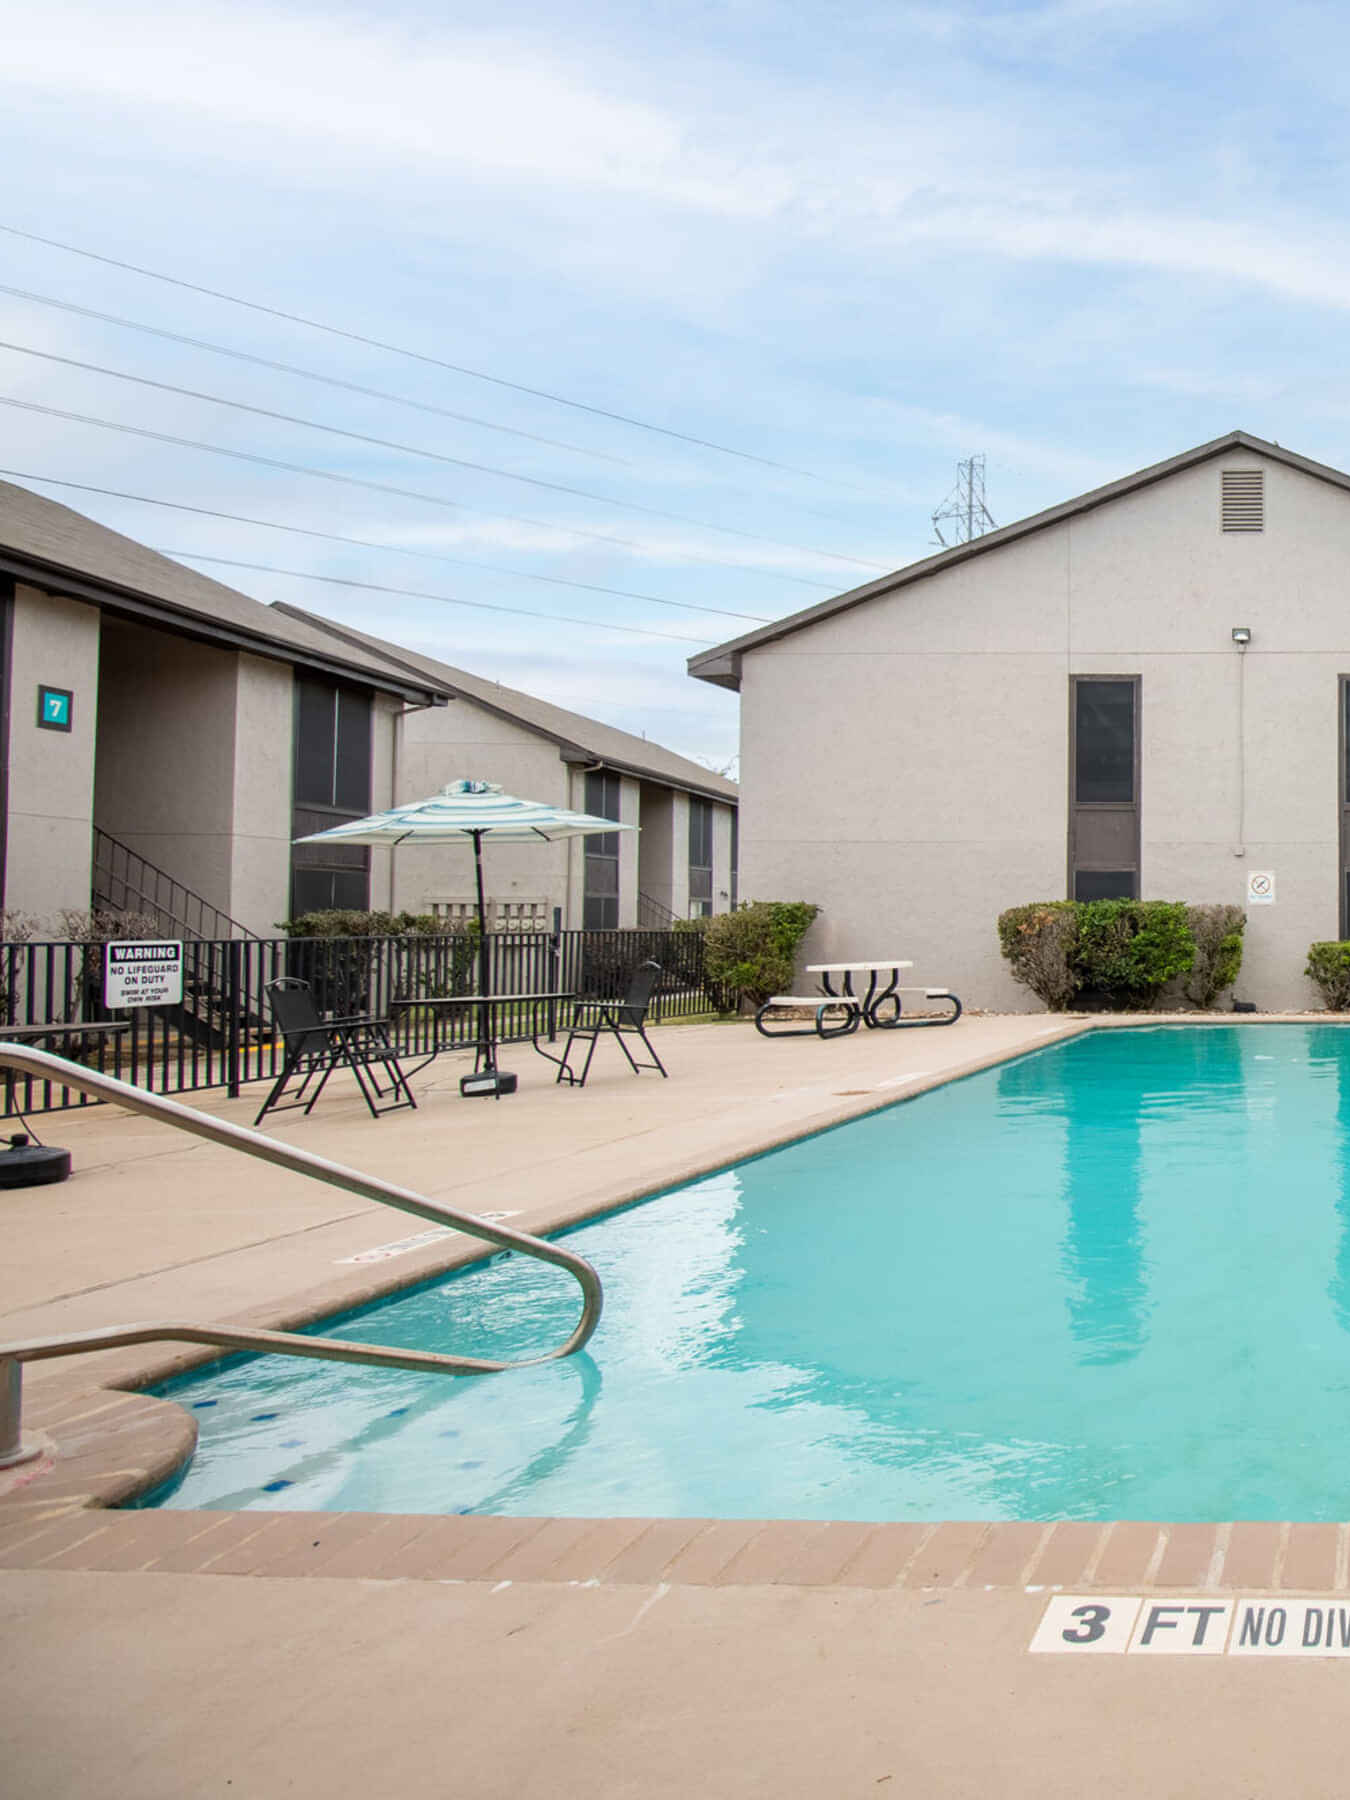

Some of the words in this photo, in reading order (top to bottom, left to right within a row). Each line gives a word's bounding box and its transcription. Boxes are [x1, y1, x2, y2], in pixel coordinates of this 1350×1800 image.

[49, 699, 62, 717] 7
[114, 946, 177, 960] WARNING
[110, 966, 124, 976] NO
[127, 964, 179, 975] LIFEGUARD
[124, 976, 138, 985] ON
[141, 975, 165, 985] DUTY
[1061, 1604, 1111, 1644] 3
[1140, 1606, 1226, 1646] FT
[1239, 1607, 1288, 1647] NO
